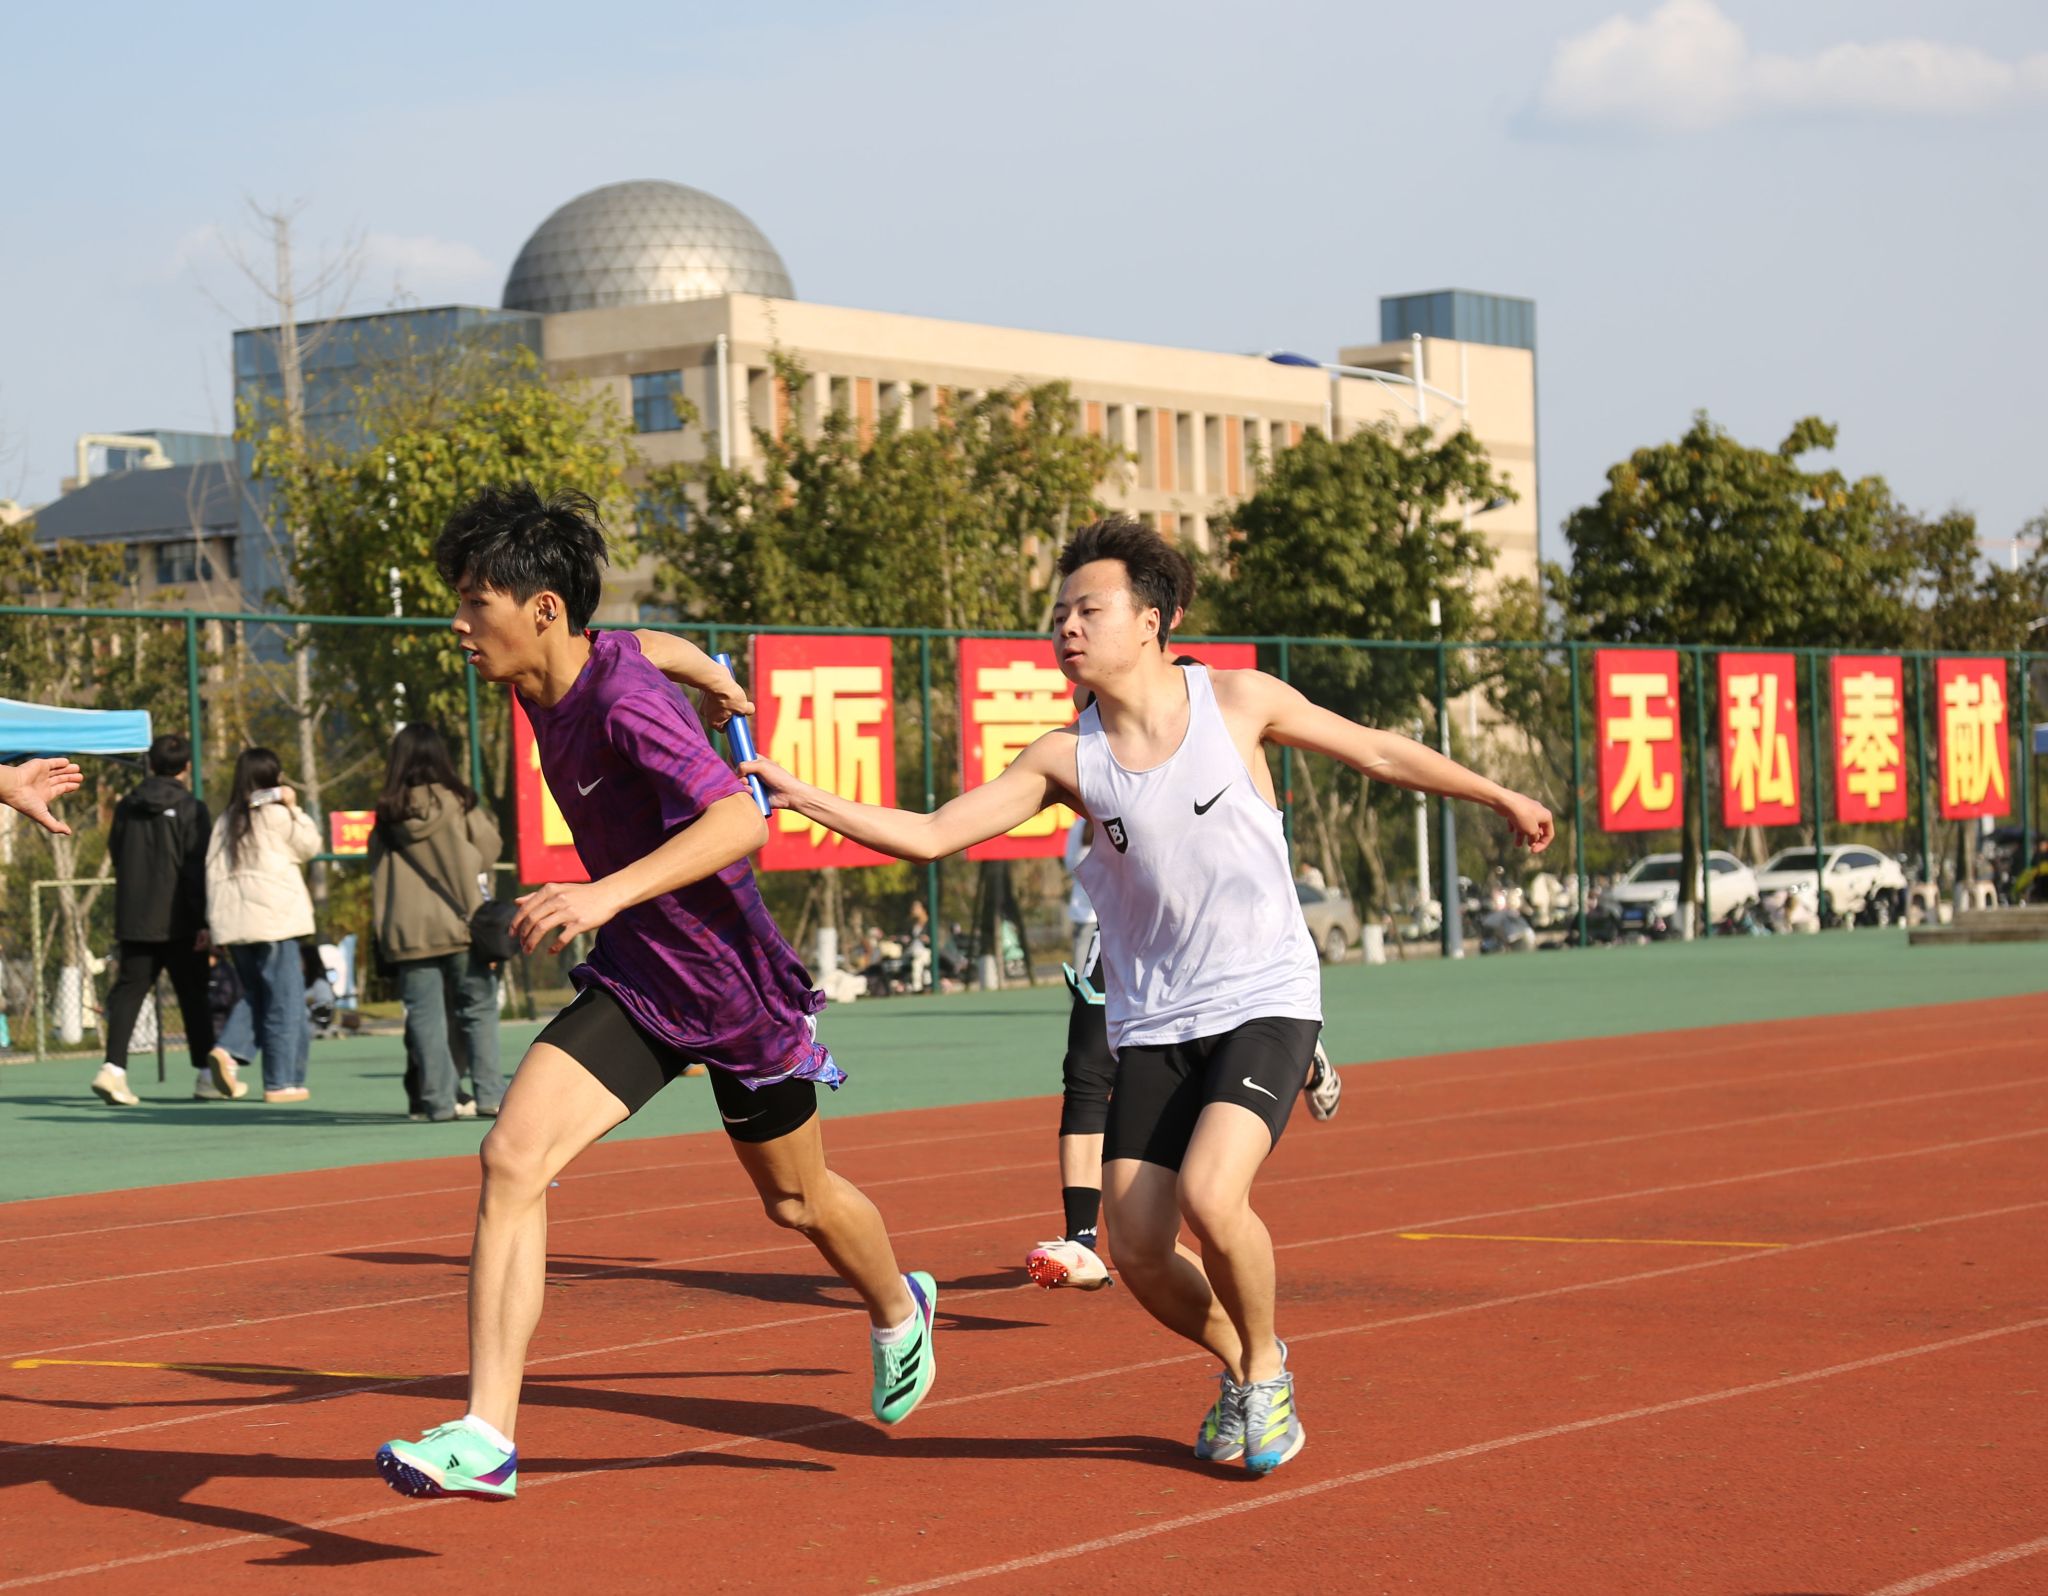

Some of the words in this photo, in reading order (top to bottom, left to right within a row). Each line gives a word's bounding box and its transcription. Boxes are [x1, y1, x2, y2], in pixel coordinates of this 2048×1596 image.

[1607, 673, 1674, 813] 无
[1728, 673, 1795, 811] 私
[1842, 672, 1900, 808] 奉
[1944, 673, 2006, 806] 献
